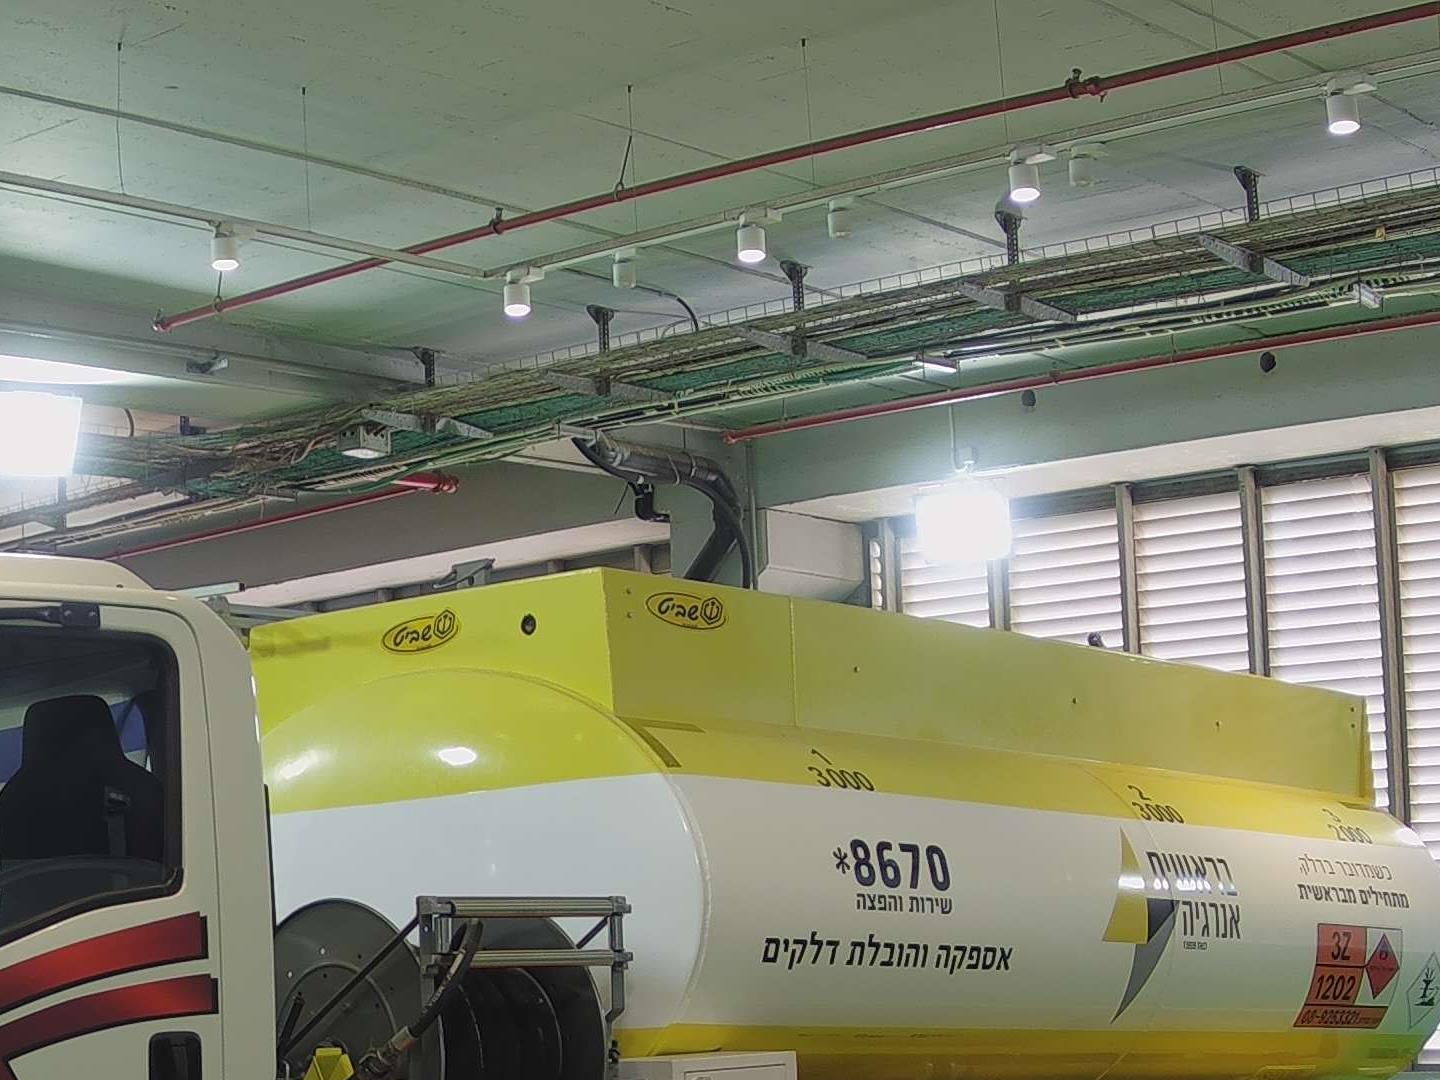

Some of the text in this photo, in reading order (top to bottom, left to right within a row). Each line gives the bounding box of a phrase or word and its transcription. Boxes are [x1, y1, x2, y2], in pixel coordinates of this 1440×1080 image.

[808, 766, 875, 791] 3000
[1131, 801, 1185, 824] 3000
[856, 892, 953, 915] שירות והפצה
[1297, 883, 1410, 909] מתחילים מבראשית
[1181, 899, 1241, 940] אנרגיה
[761, 931, 1013, 975] אספקה והובלת דלקים
[1314, 973, 1357, 1001] 1202
